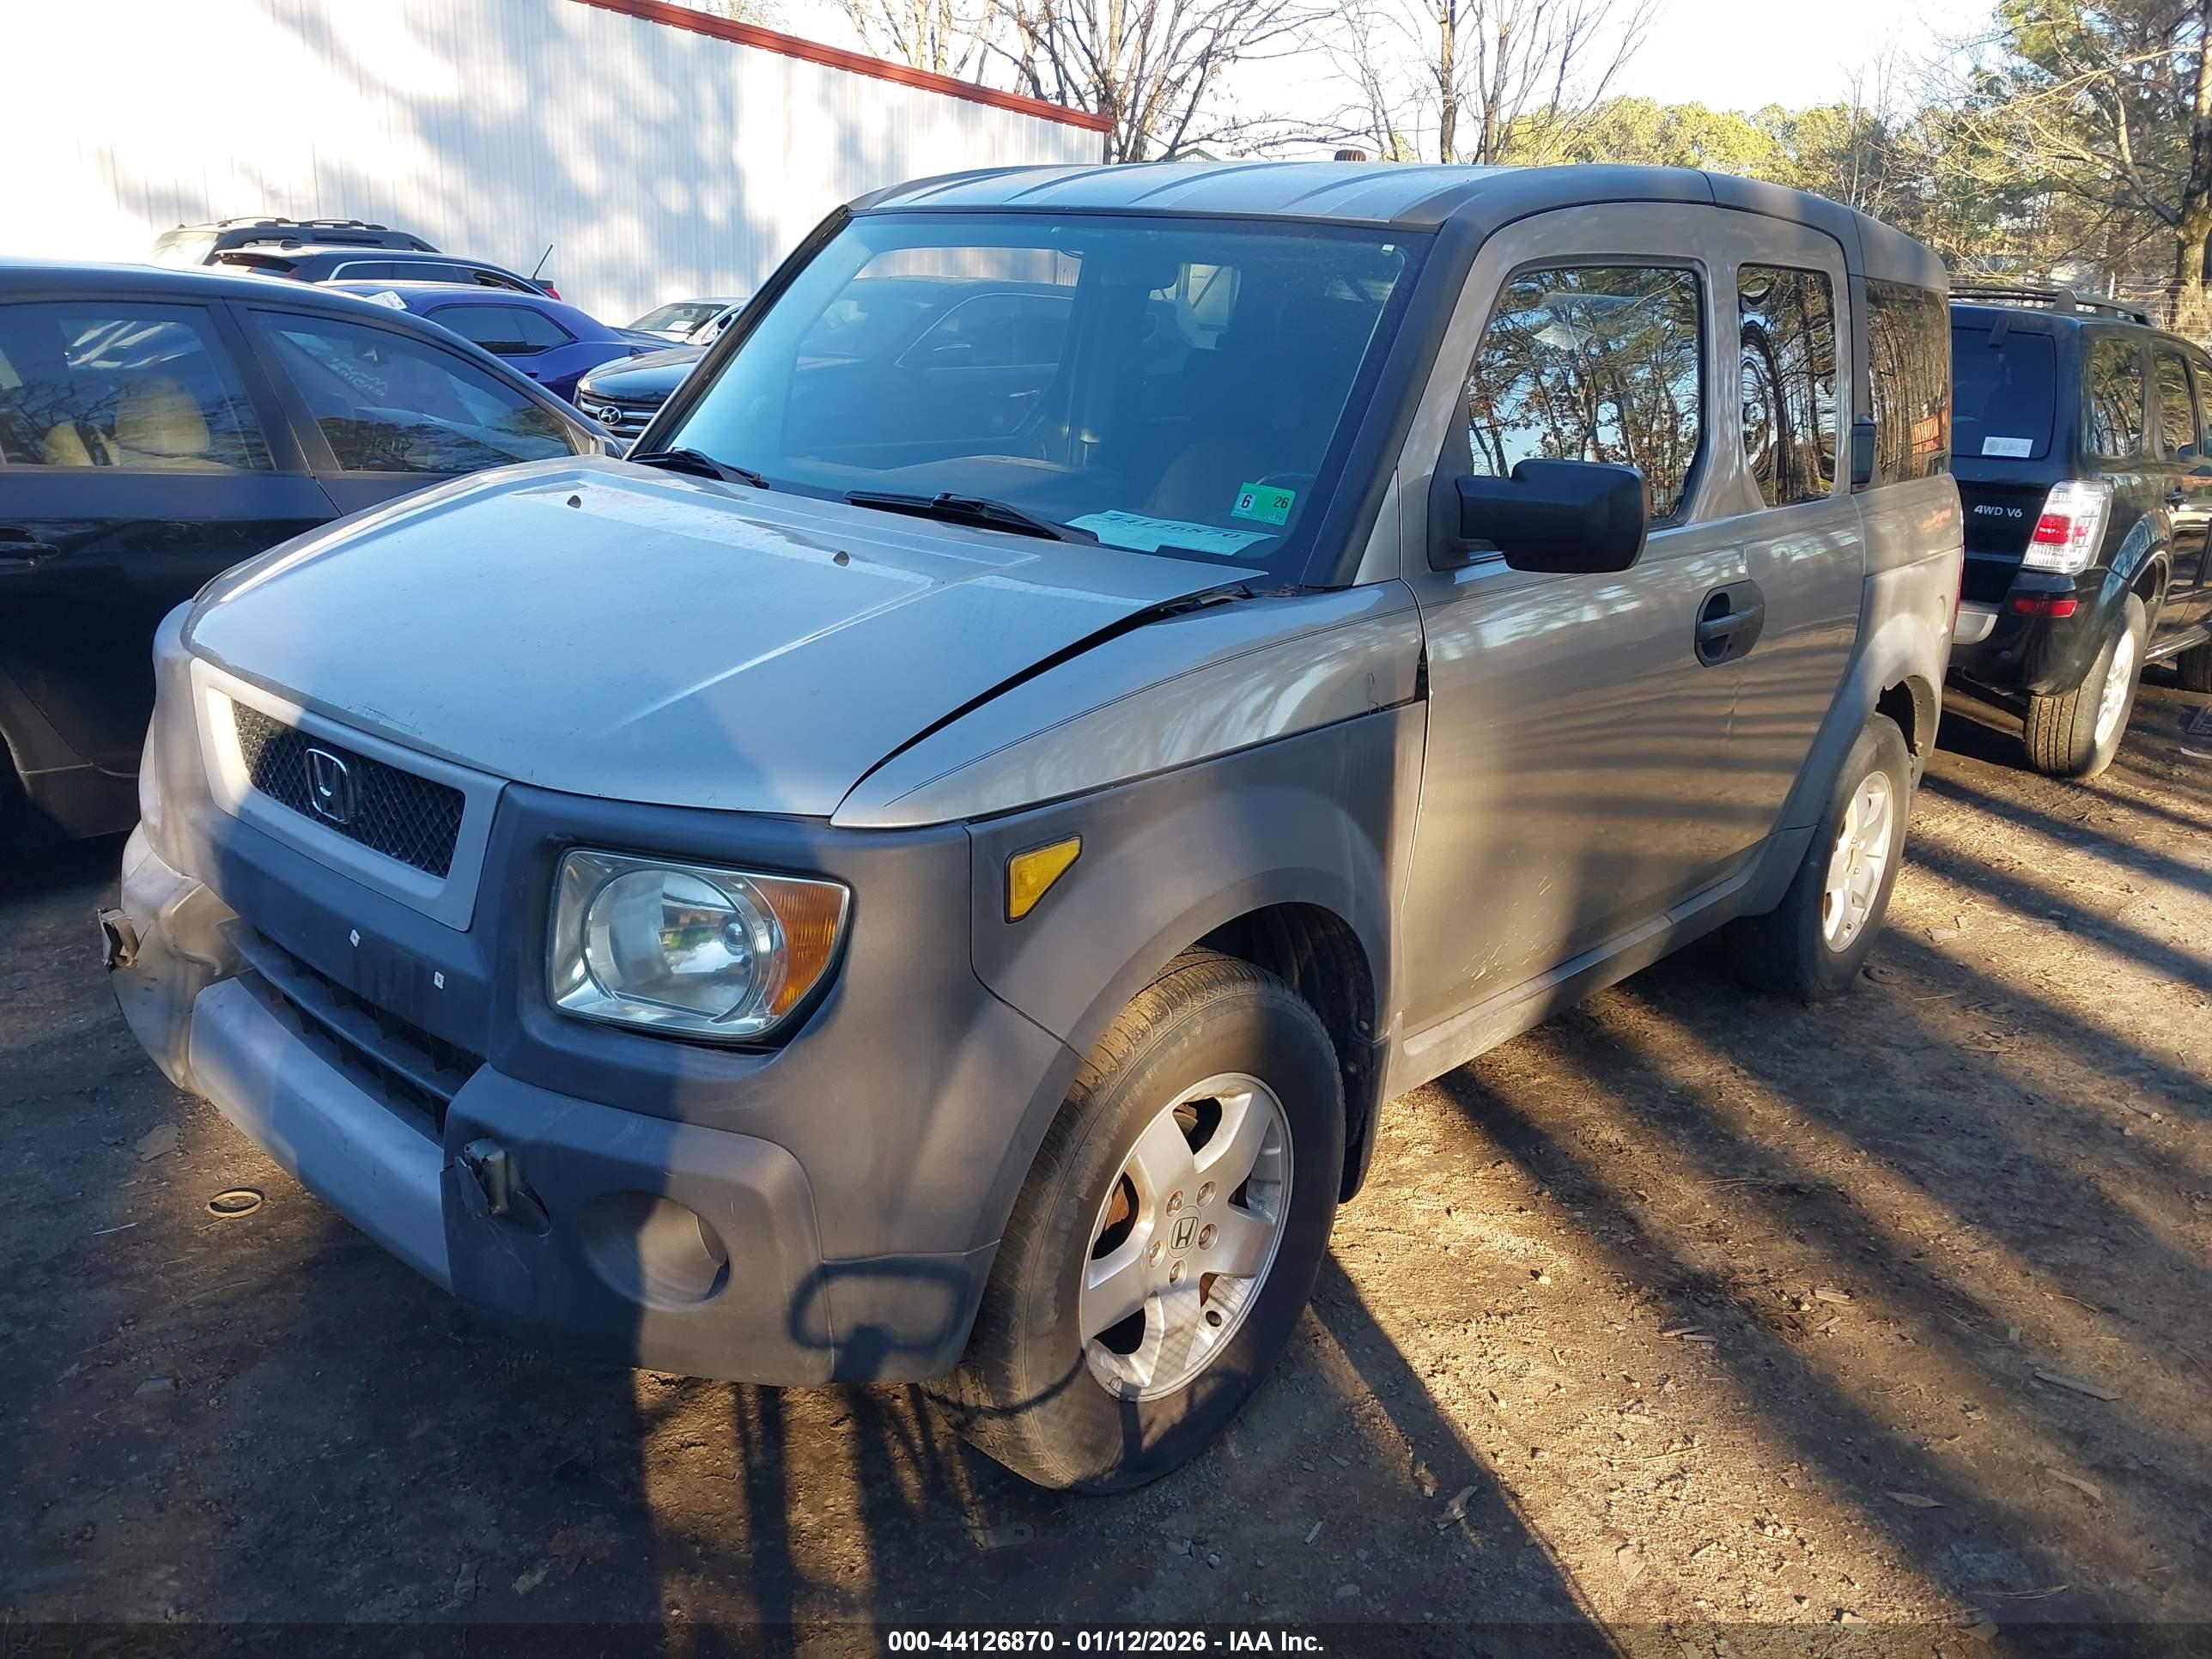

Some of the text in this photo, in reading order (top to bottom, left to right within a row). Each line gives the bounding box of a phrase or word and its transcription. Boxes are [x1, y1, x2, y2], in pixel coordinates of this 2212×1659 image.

[1242, 495, 1290, 508] 6 26
[1974, 504, 2023, 518] 4WD V6
